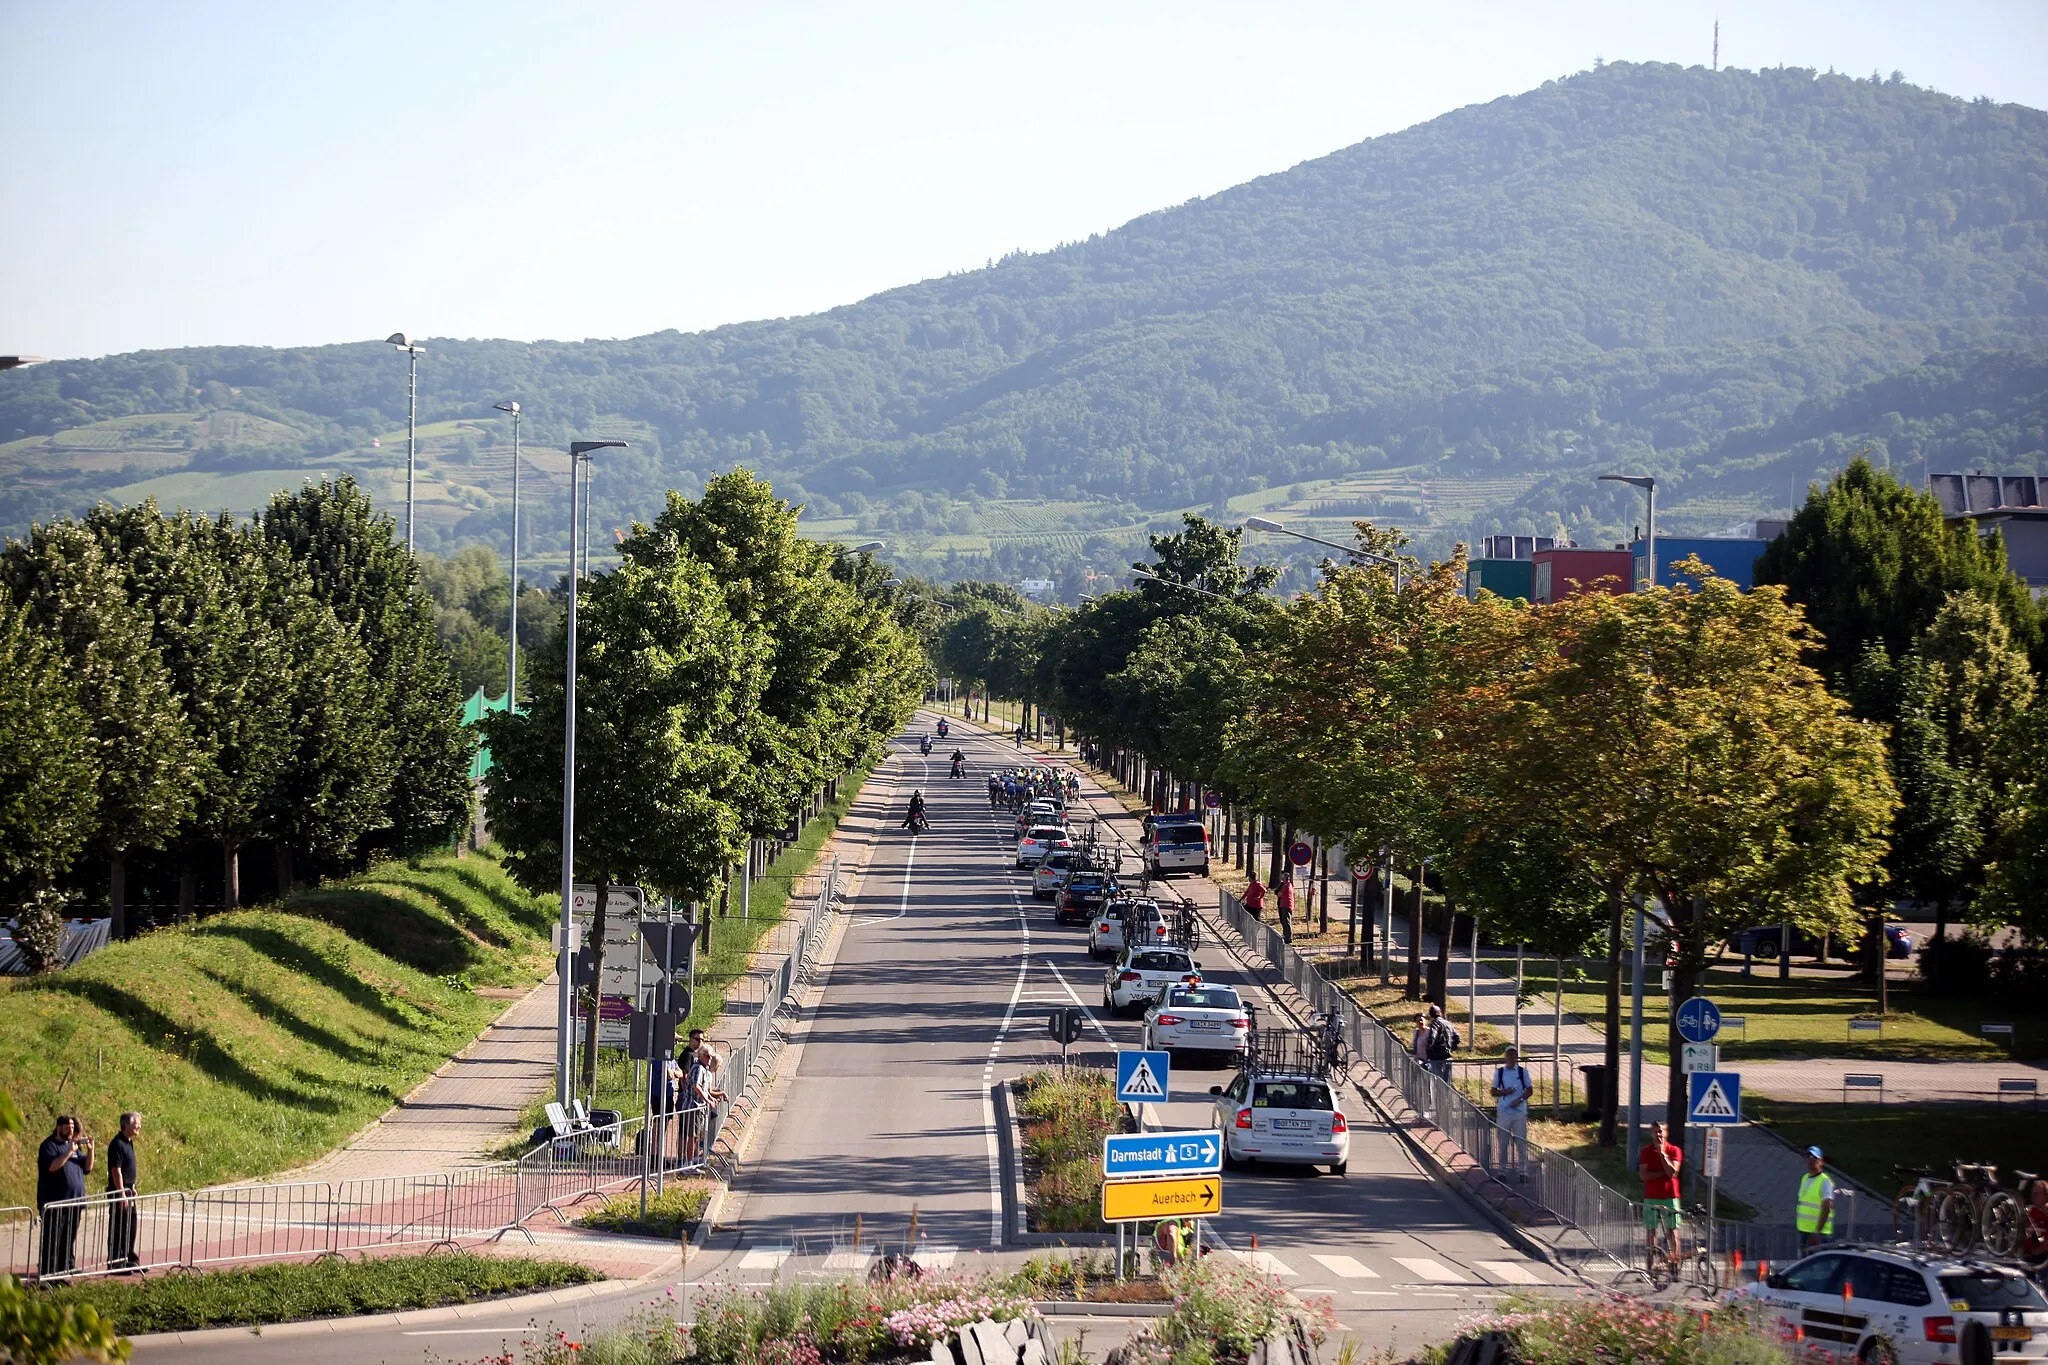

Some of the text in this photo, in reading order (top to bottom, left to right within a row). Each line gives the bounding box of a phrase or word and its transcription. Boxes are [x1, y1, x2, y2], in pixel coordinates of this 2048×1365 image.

[1697, 1062, 1709, 1072] R8
[1111, 1147, 1162, 1163] Darmstadt
[1152, 1191, 1196, 1204] Auerbach
